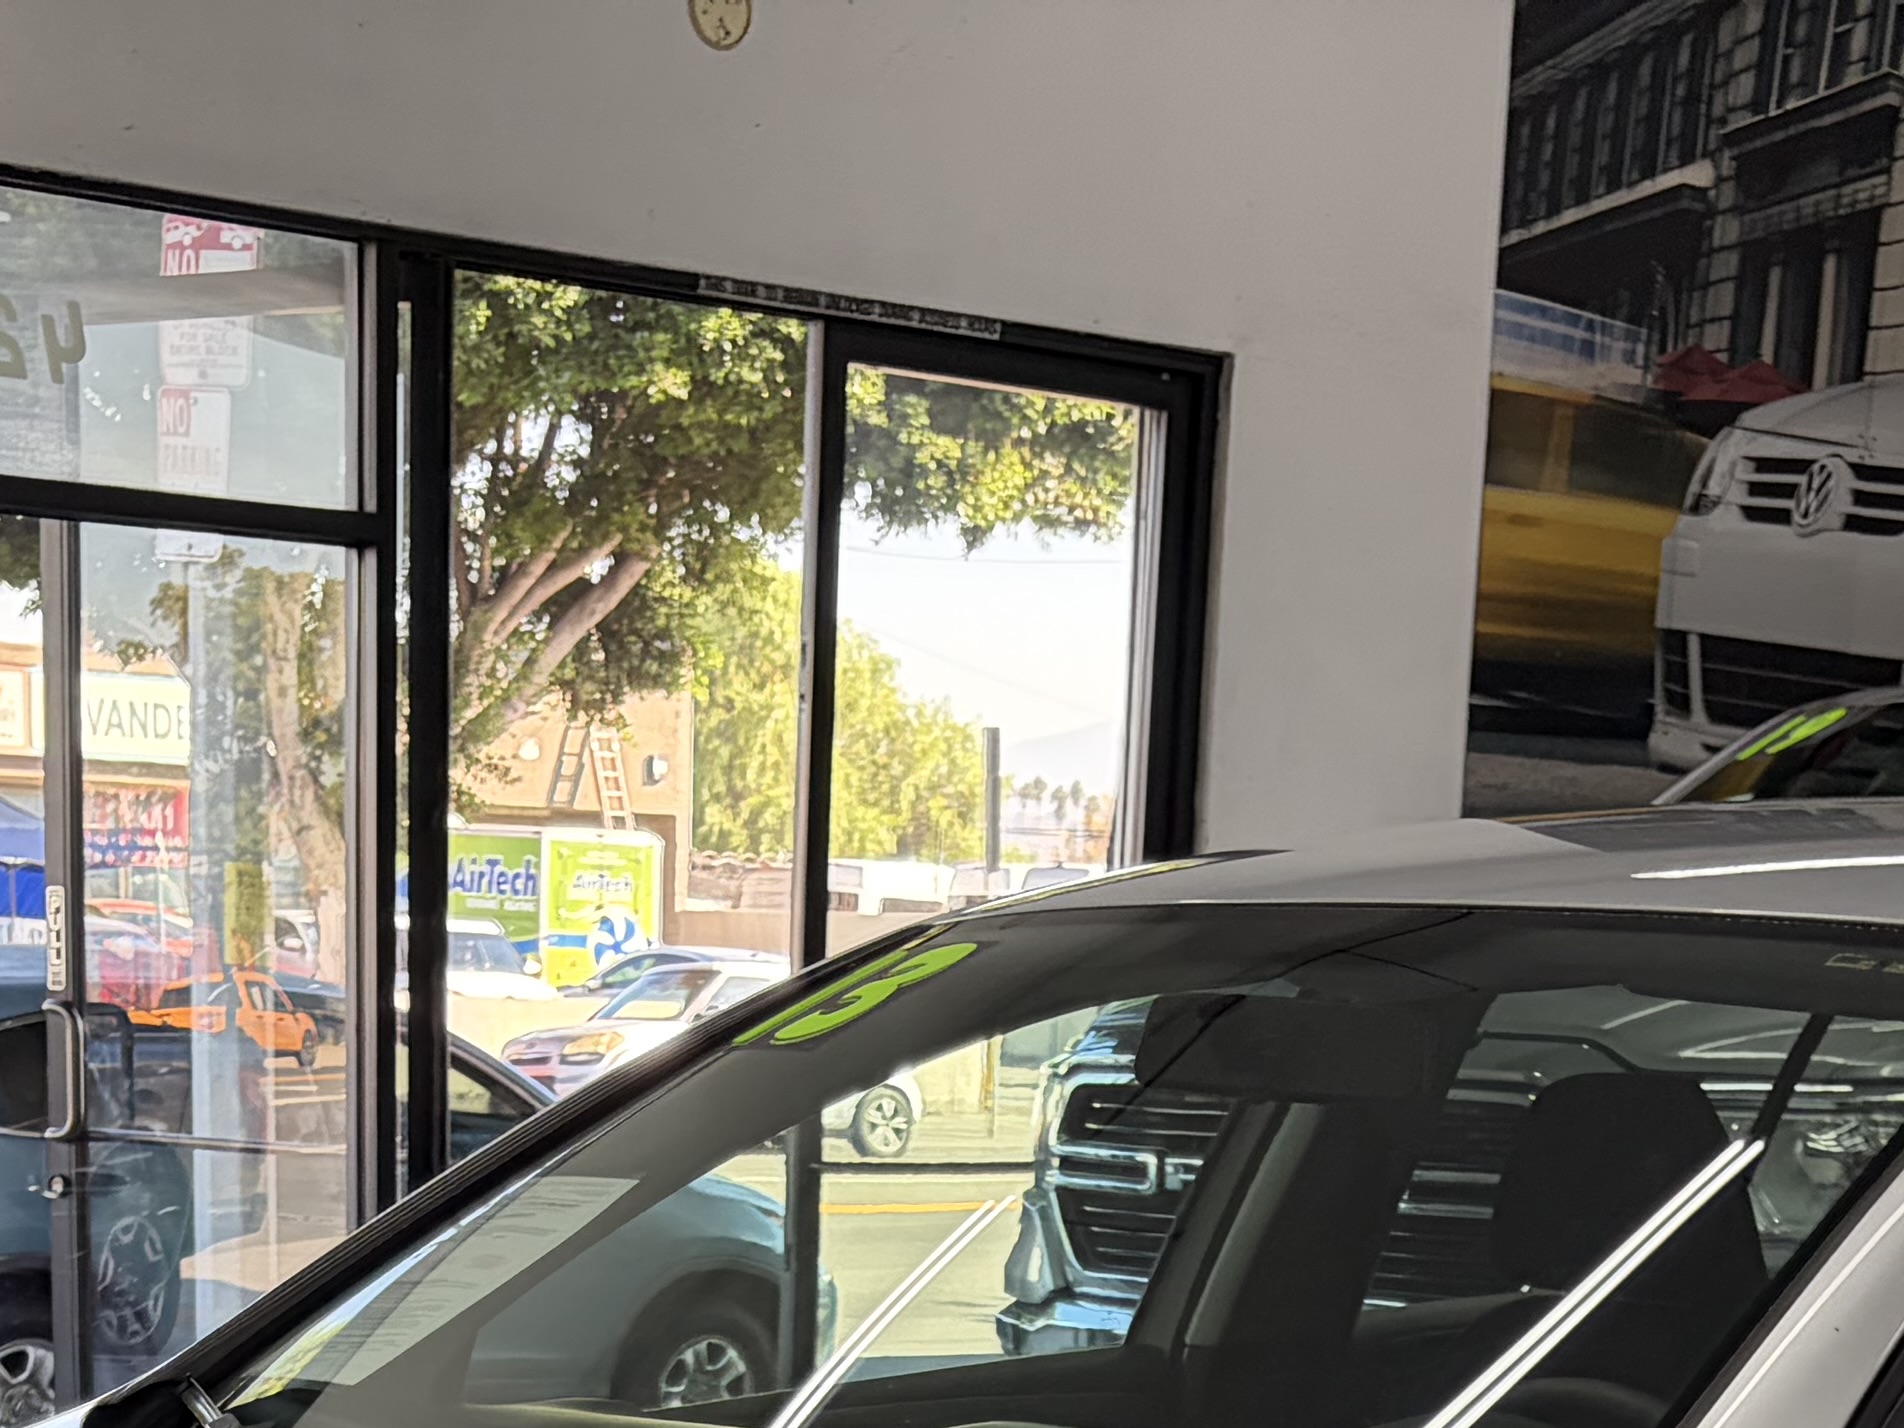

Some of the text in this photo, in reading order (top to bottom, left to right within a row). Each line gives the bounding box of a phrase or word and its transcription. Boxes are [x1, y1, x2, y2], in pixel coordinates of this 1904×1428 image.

[160, 396, 191, 435] NO
[87, 698, 186, 740] VANDE
[451, 856, 538, 897] AirTech
